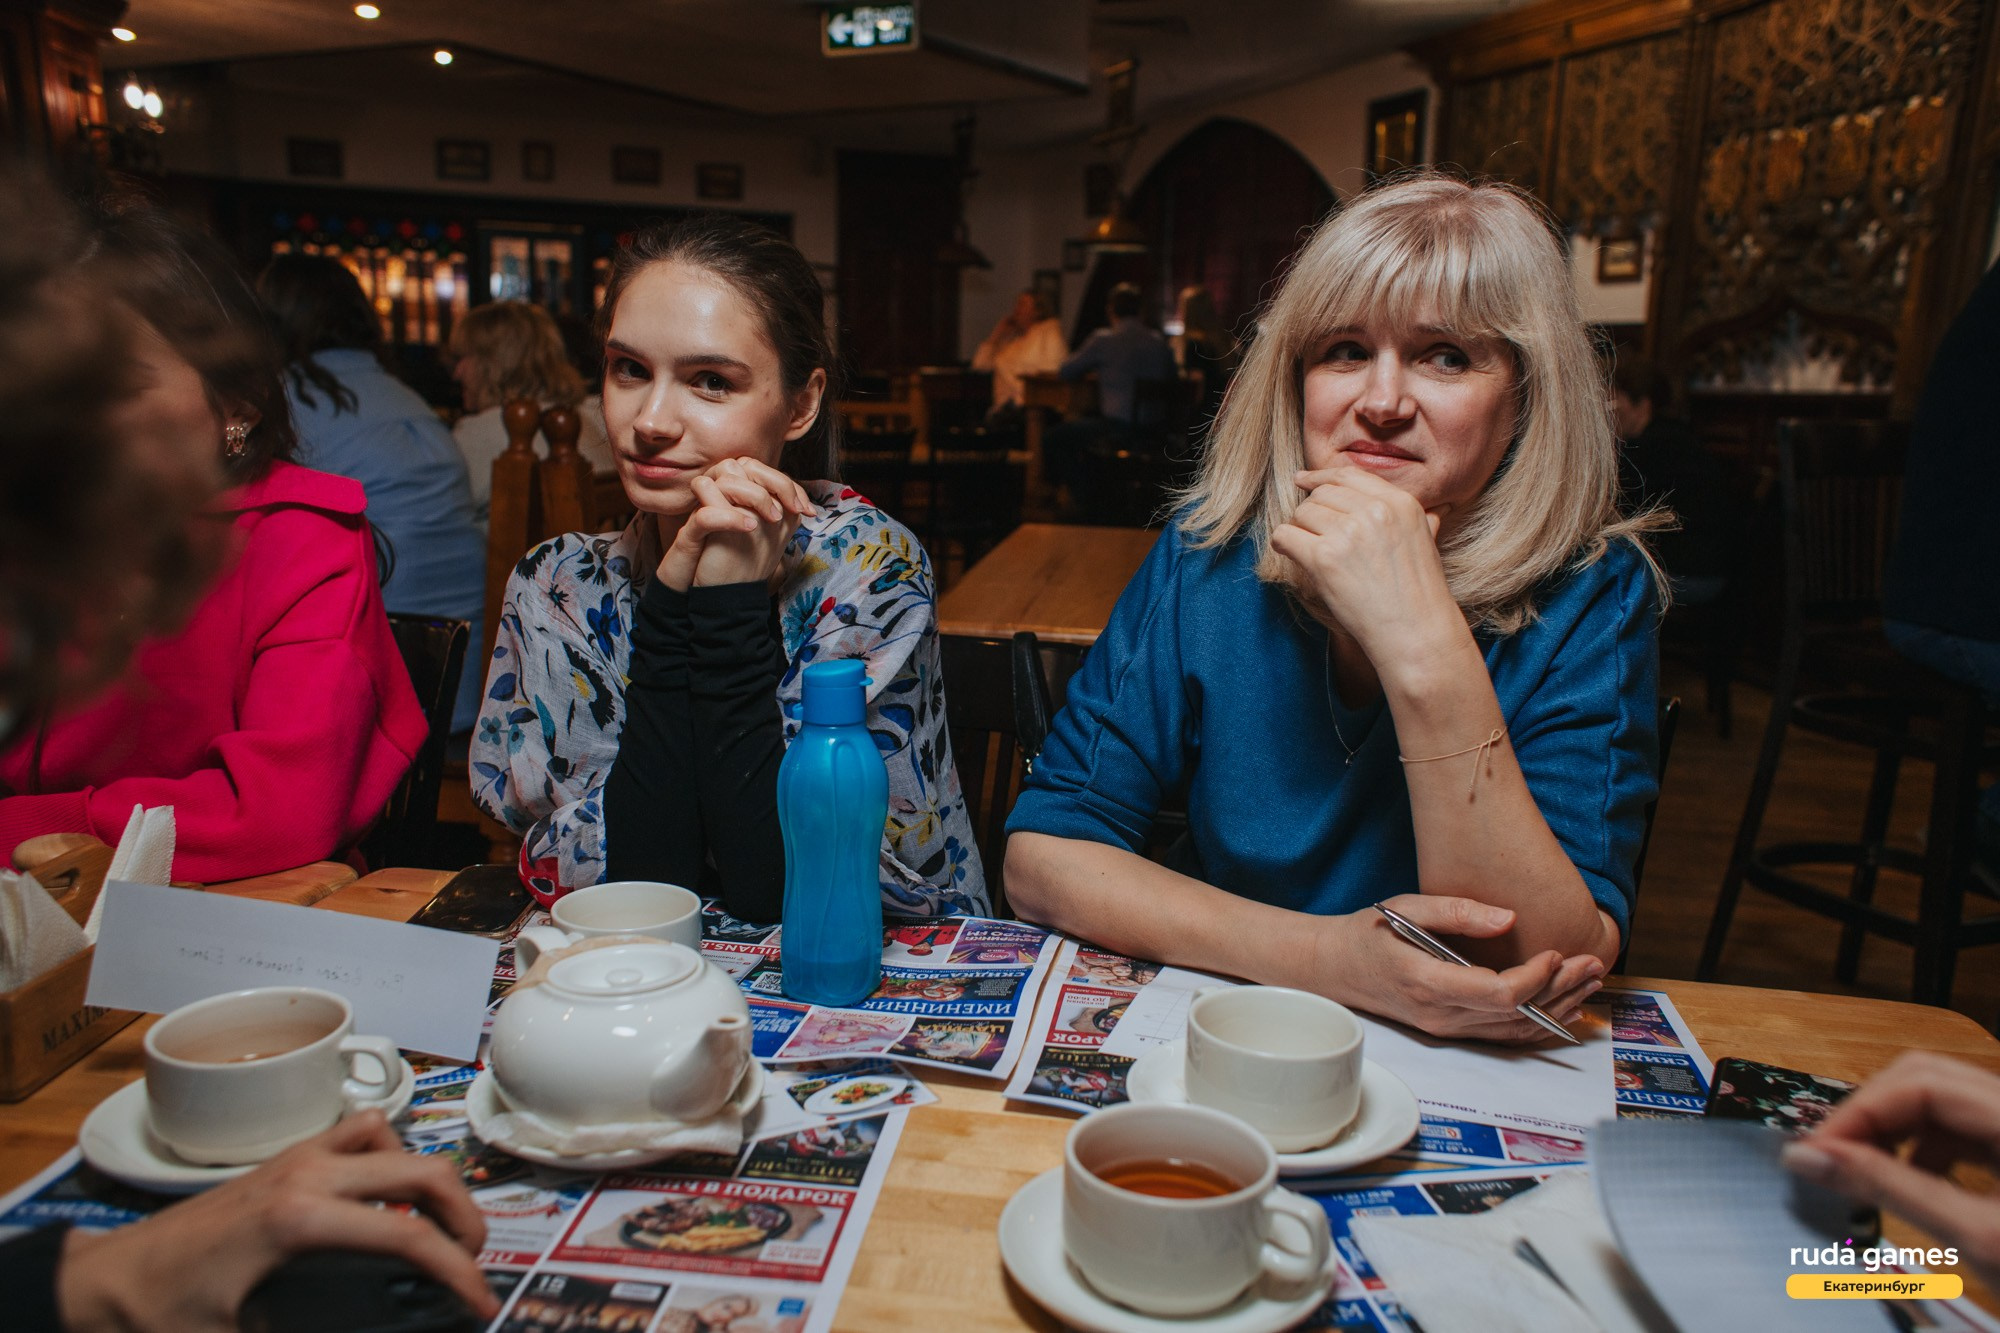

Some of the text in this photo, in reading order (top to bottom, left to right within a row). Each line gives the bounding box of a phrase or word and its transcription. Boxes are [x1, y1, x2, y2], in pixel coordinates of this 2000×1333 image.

[42, 1005, 111, 1053] MAXIM
[917, 1023, 1005, 1034] ЦАРИЦА
[702, 1181, 721, 1194] В
[723, 1183, 849, 1206] ПОДАРОК
